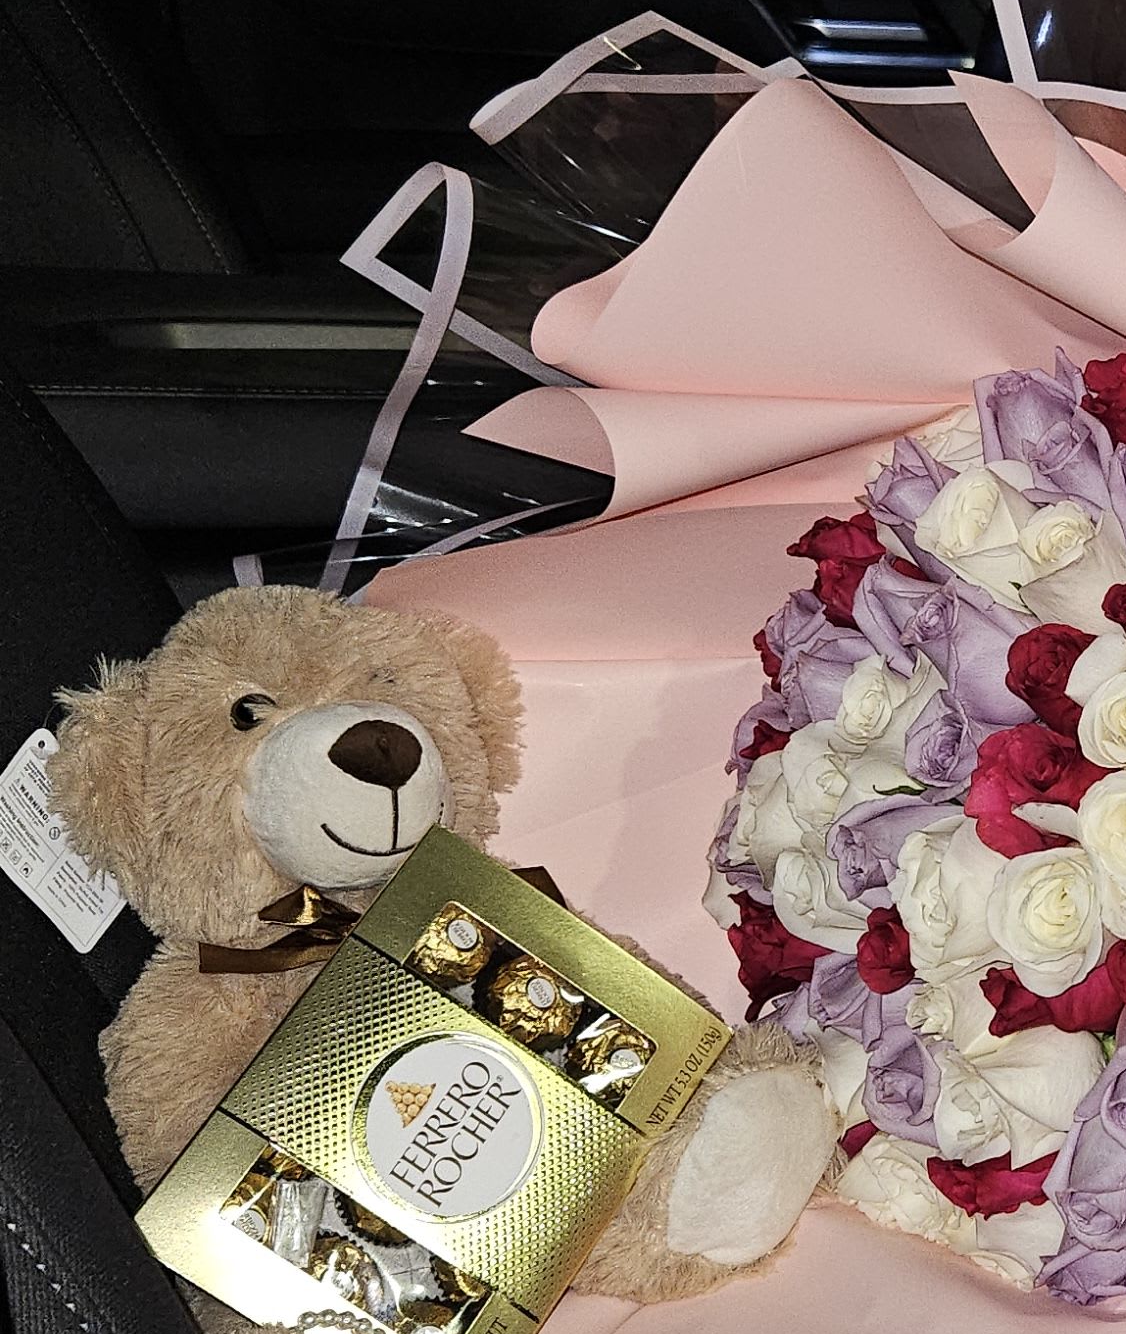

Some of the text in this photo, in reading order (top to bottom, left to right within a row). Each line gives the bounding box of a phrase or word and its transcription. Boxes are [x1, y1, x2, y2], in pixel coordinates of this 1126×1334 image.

[389, 1061, 491, 1189] FERRERO
[645, 1026, 722, 1125] NET WT 5.3 OZ (150g)
